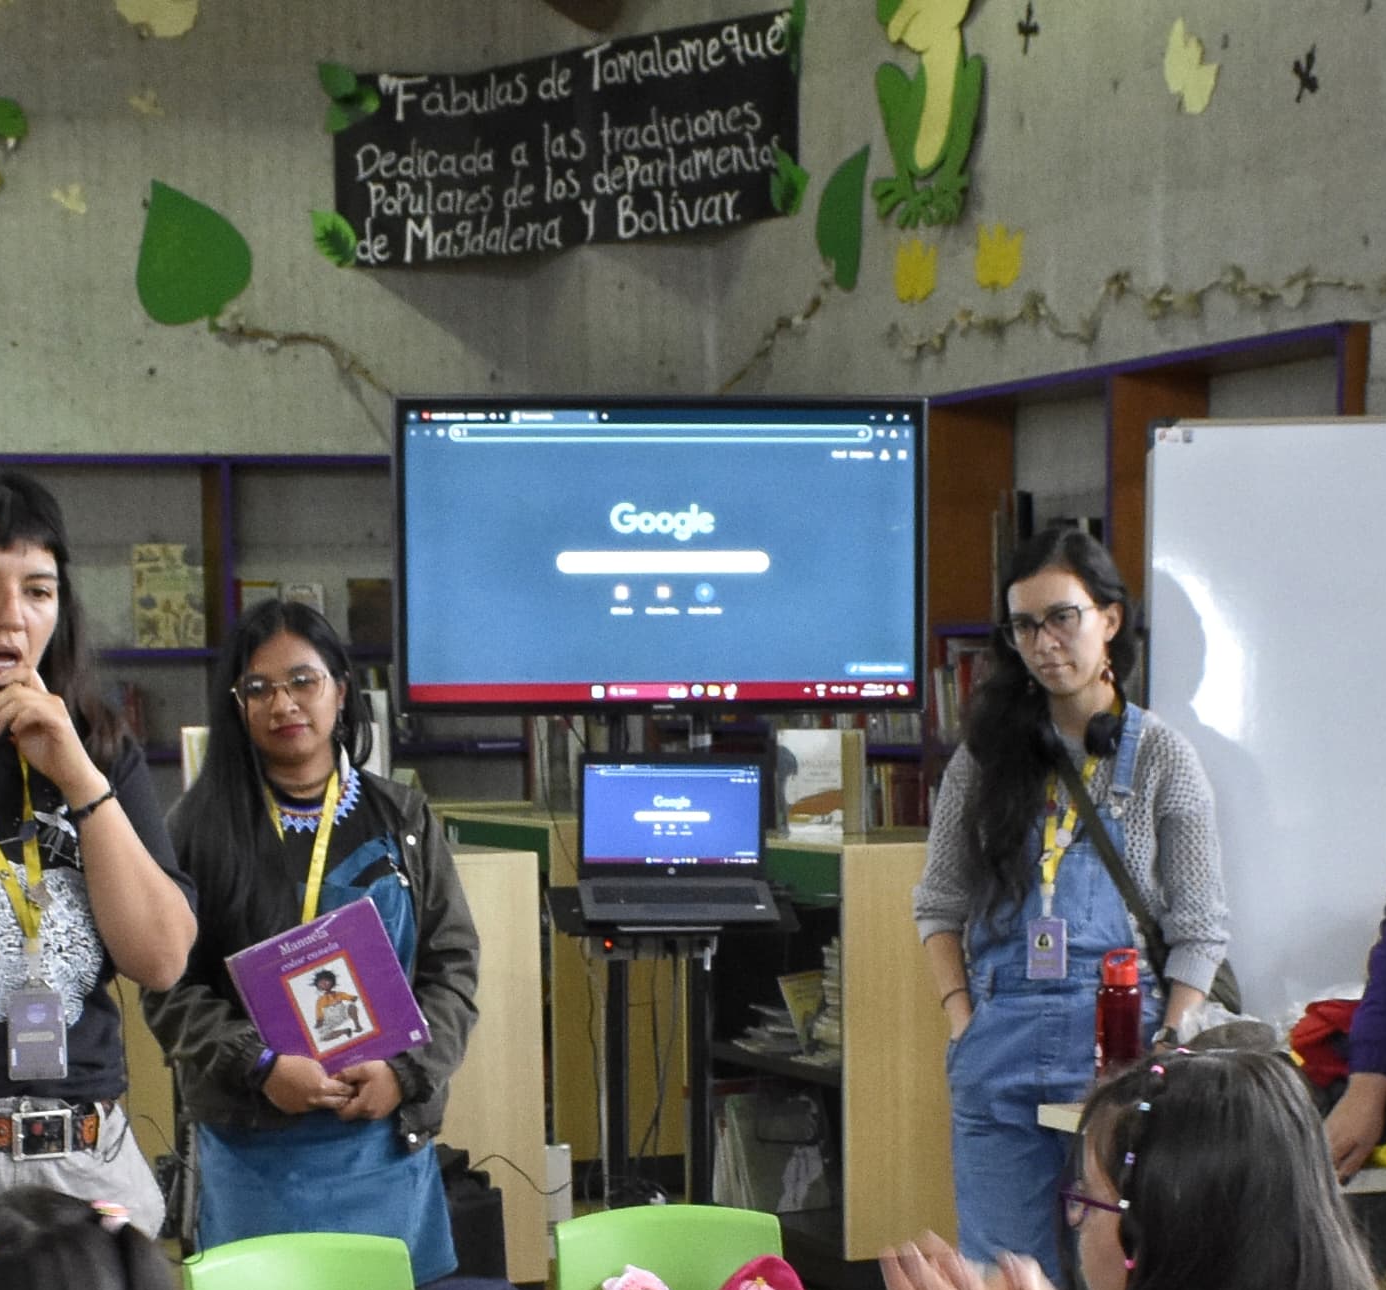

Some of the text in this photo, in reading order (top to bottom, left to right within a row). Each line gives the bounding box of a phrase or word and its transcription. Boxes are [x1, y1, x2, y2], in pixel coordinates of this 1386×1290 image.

[538, 57, 571, 101] de
[355, 101, 762, 181] Dedicada a las tradiciones
[503, 169, 535, 211] de
[546, 165, 581, 203] los
[355, 217, 391, 264] de
[403, 210, 562, 263] Magdalena
[610, 502, 715, 541] Google
